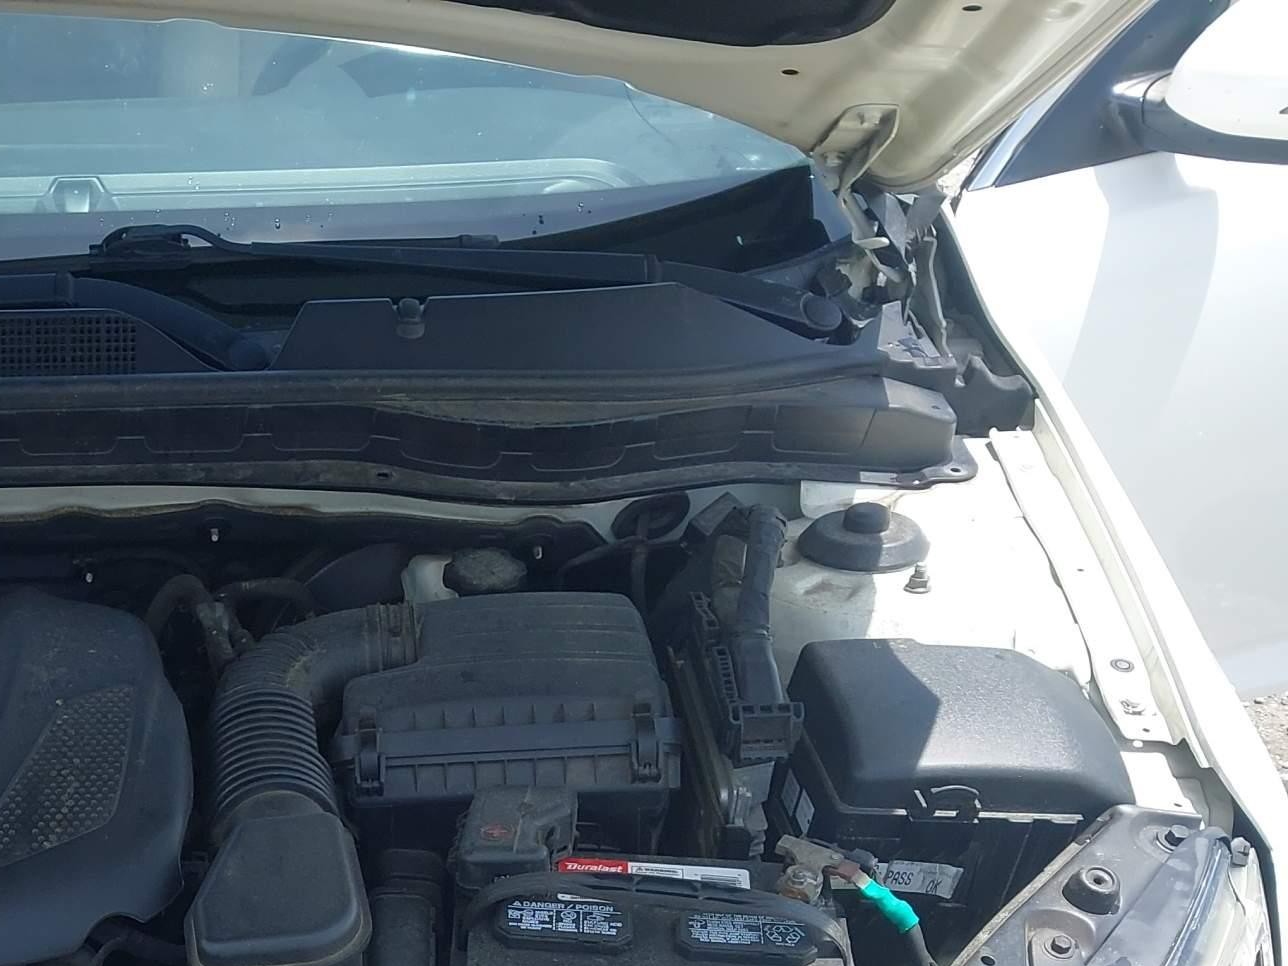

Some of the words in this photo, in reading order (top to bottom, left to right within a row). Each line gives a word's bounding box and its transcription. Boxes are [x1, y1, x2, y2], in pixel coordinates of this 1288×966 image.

[565, 861, 623, 873] Duralast
[883, 870, 915, 887] PASS
[925, 879, 943, 894] OK
[523, 901, 565, 909] DANGER
[575, 904, 614, 912] POISON
